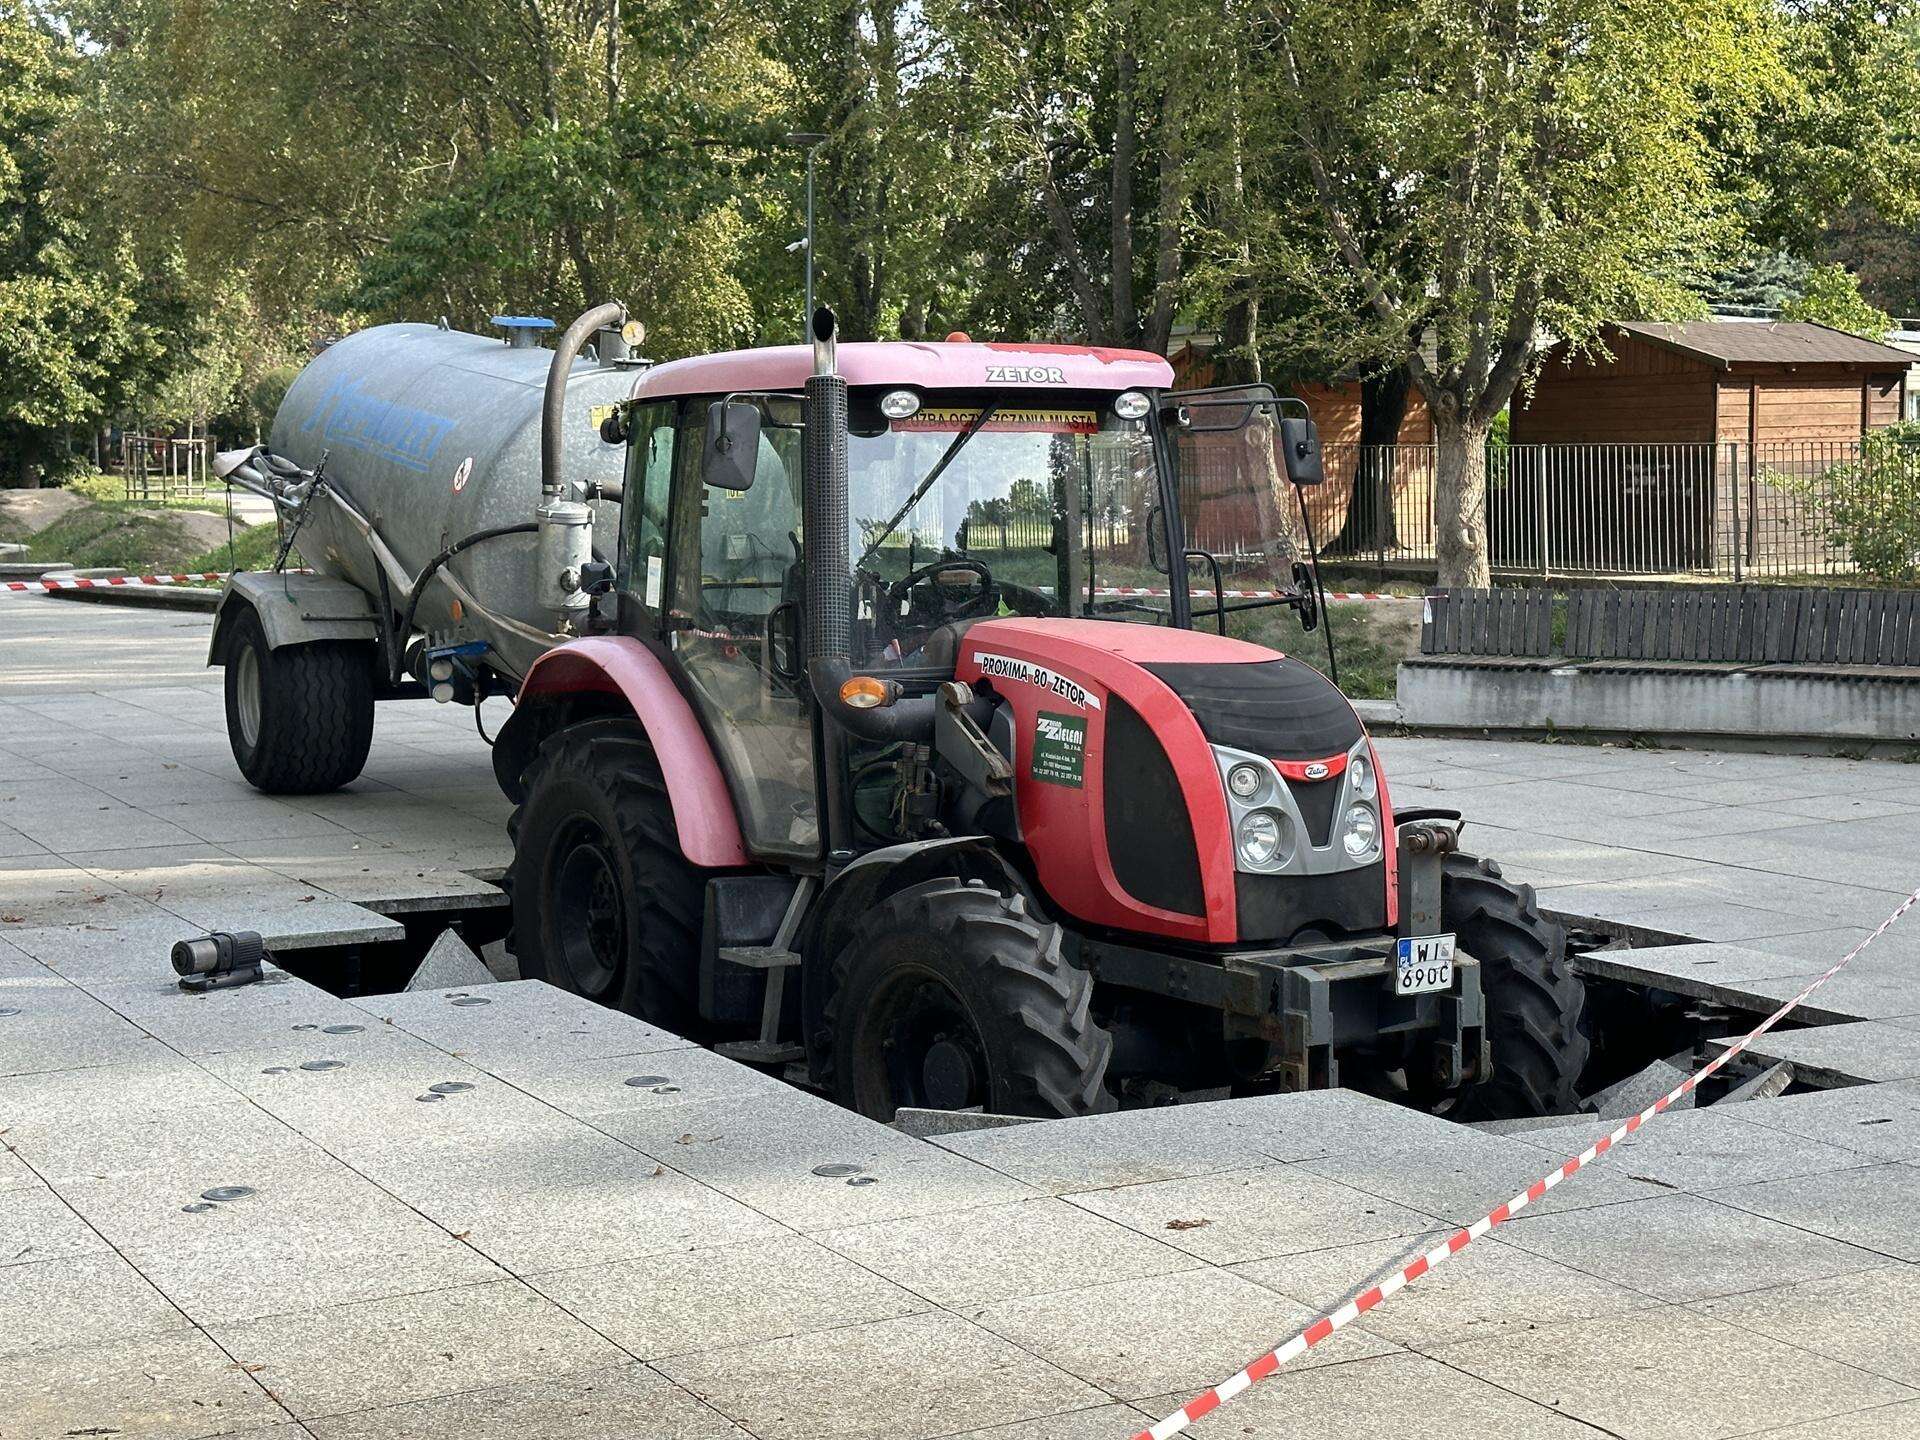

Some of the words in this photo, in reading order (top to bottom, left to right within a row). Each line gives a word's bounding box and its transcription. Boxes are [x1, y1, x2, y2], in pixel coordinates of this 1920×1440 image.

[985, 365, 1067, 384] ZETOR
[1049, 413, 1095, 430] MIASTA
[982, 656, 1028, 682] PROXIMA
[1033, 668, 1048, 688] 80
[1052, 675, 1086, 708] ZETOR
[1307, 767, 1328, 776] Zetor
[1417, 943, 1439, 962] WI
[1402, 965, 1449, 988] 690C
